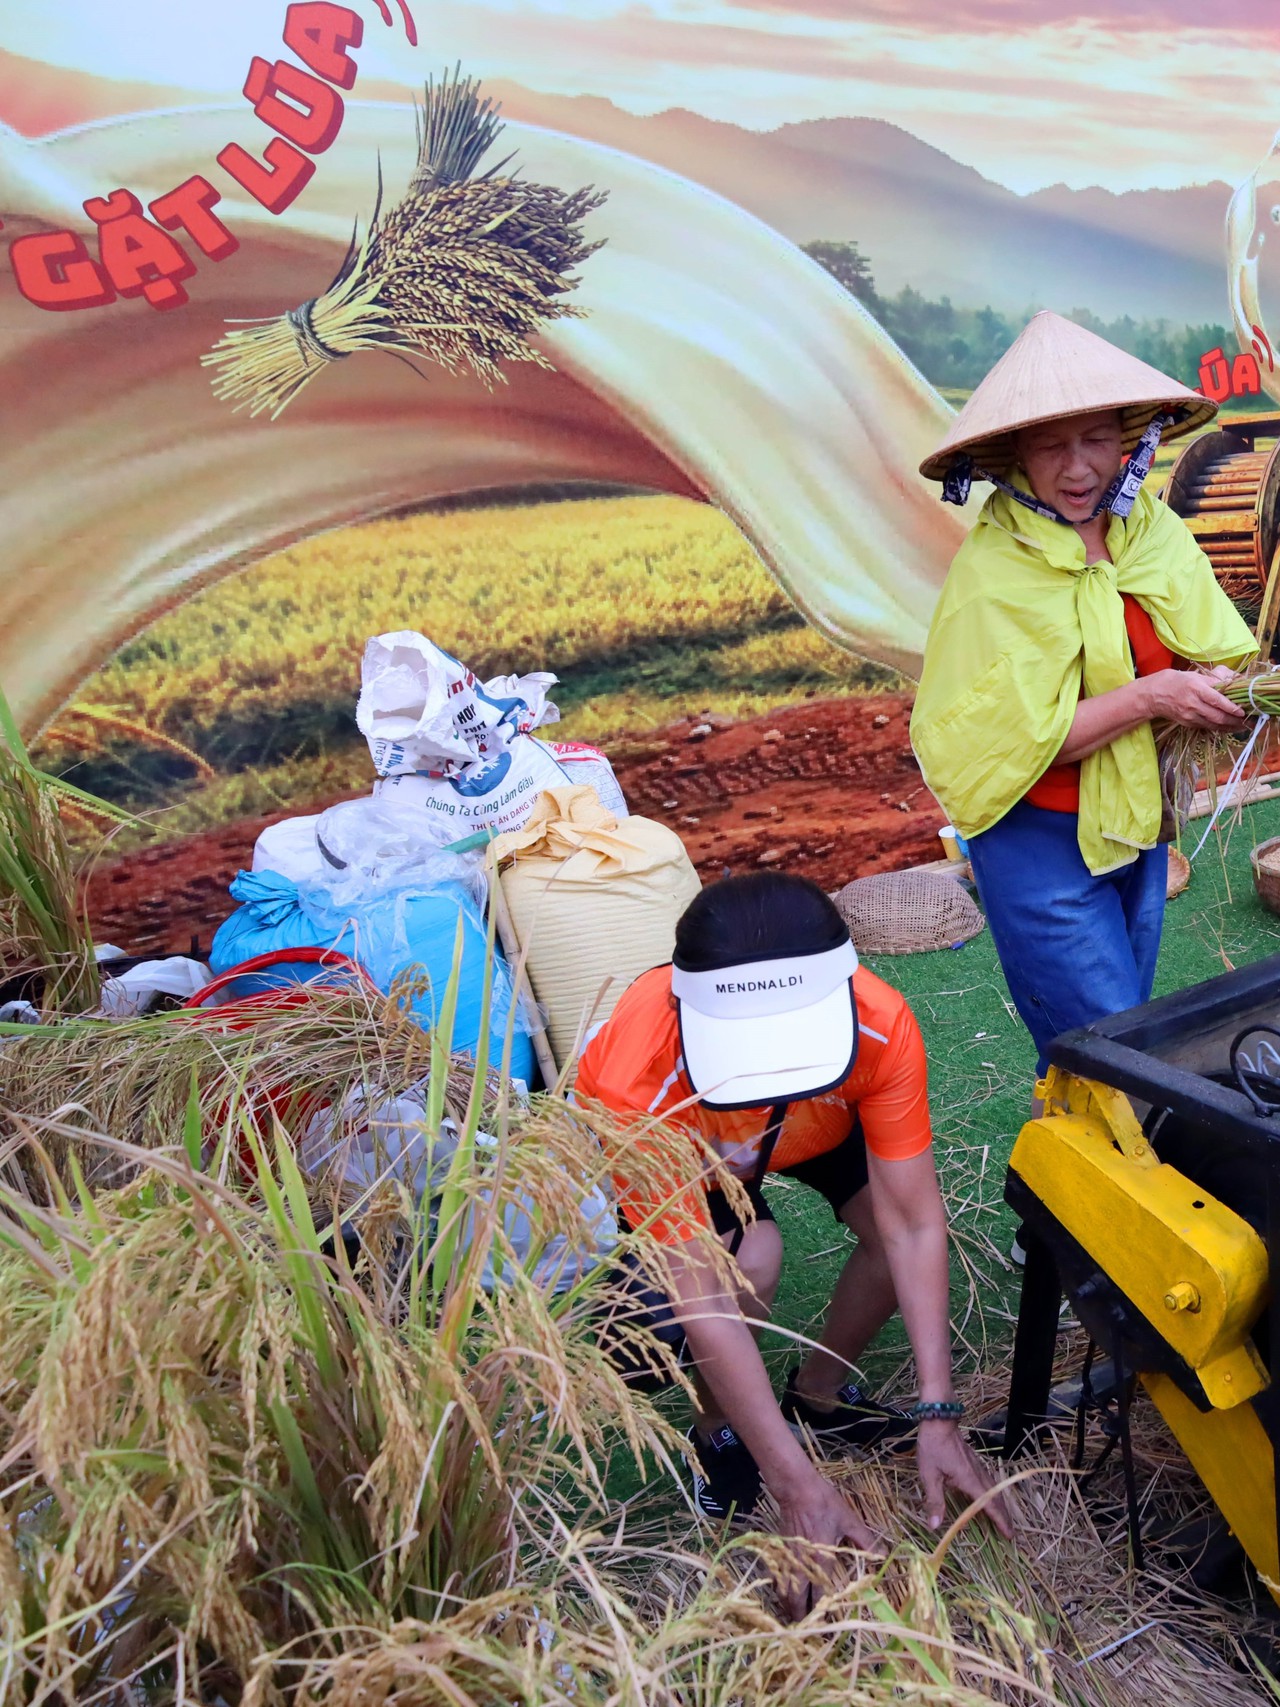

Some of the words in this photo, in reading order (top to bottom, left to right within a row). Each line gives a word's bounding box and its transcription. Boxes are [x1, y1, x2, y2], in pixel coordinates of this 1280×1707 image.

[9, 174, 241, 312] GẶT
[1193, 346, 1263, 405] ÚA
[426, 796, 456, 816] Chúng
[459, 804, 471, 816] Ta
[500, 788, 518, 806] Làm
[715, 974, 803, 993] MENDNALDI
